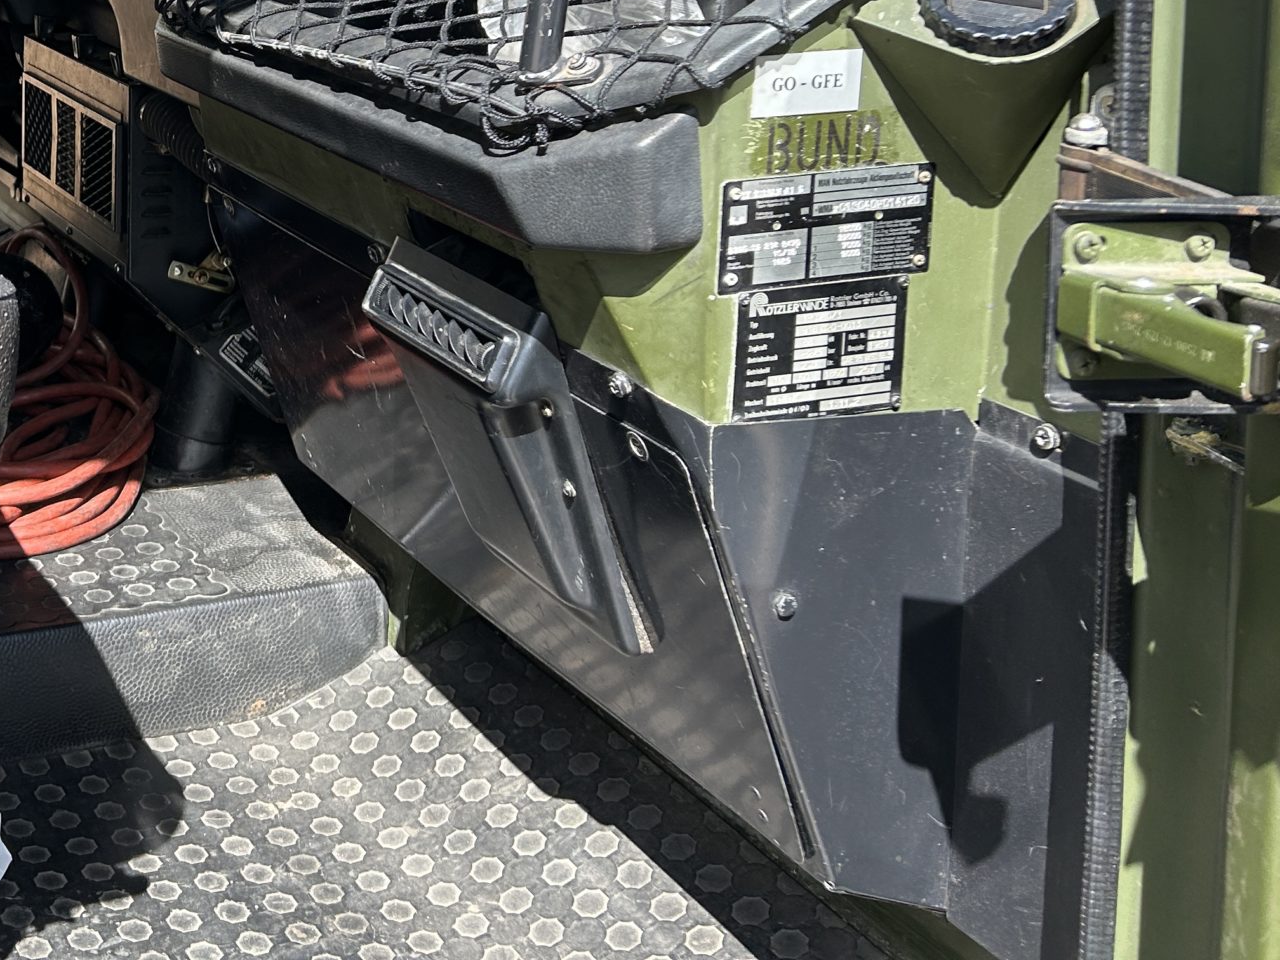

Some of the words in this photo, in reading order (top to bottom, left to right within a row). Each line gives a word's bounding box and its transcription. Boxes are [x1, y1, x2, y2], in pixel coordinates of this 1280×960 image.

[772, 77, 797, 91] GO
[811, 73, 844, 89] GFE
[767, 115, 881, 174] BUND
